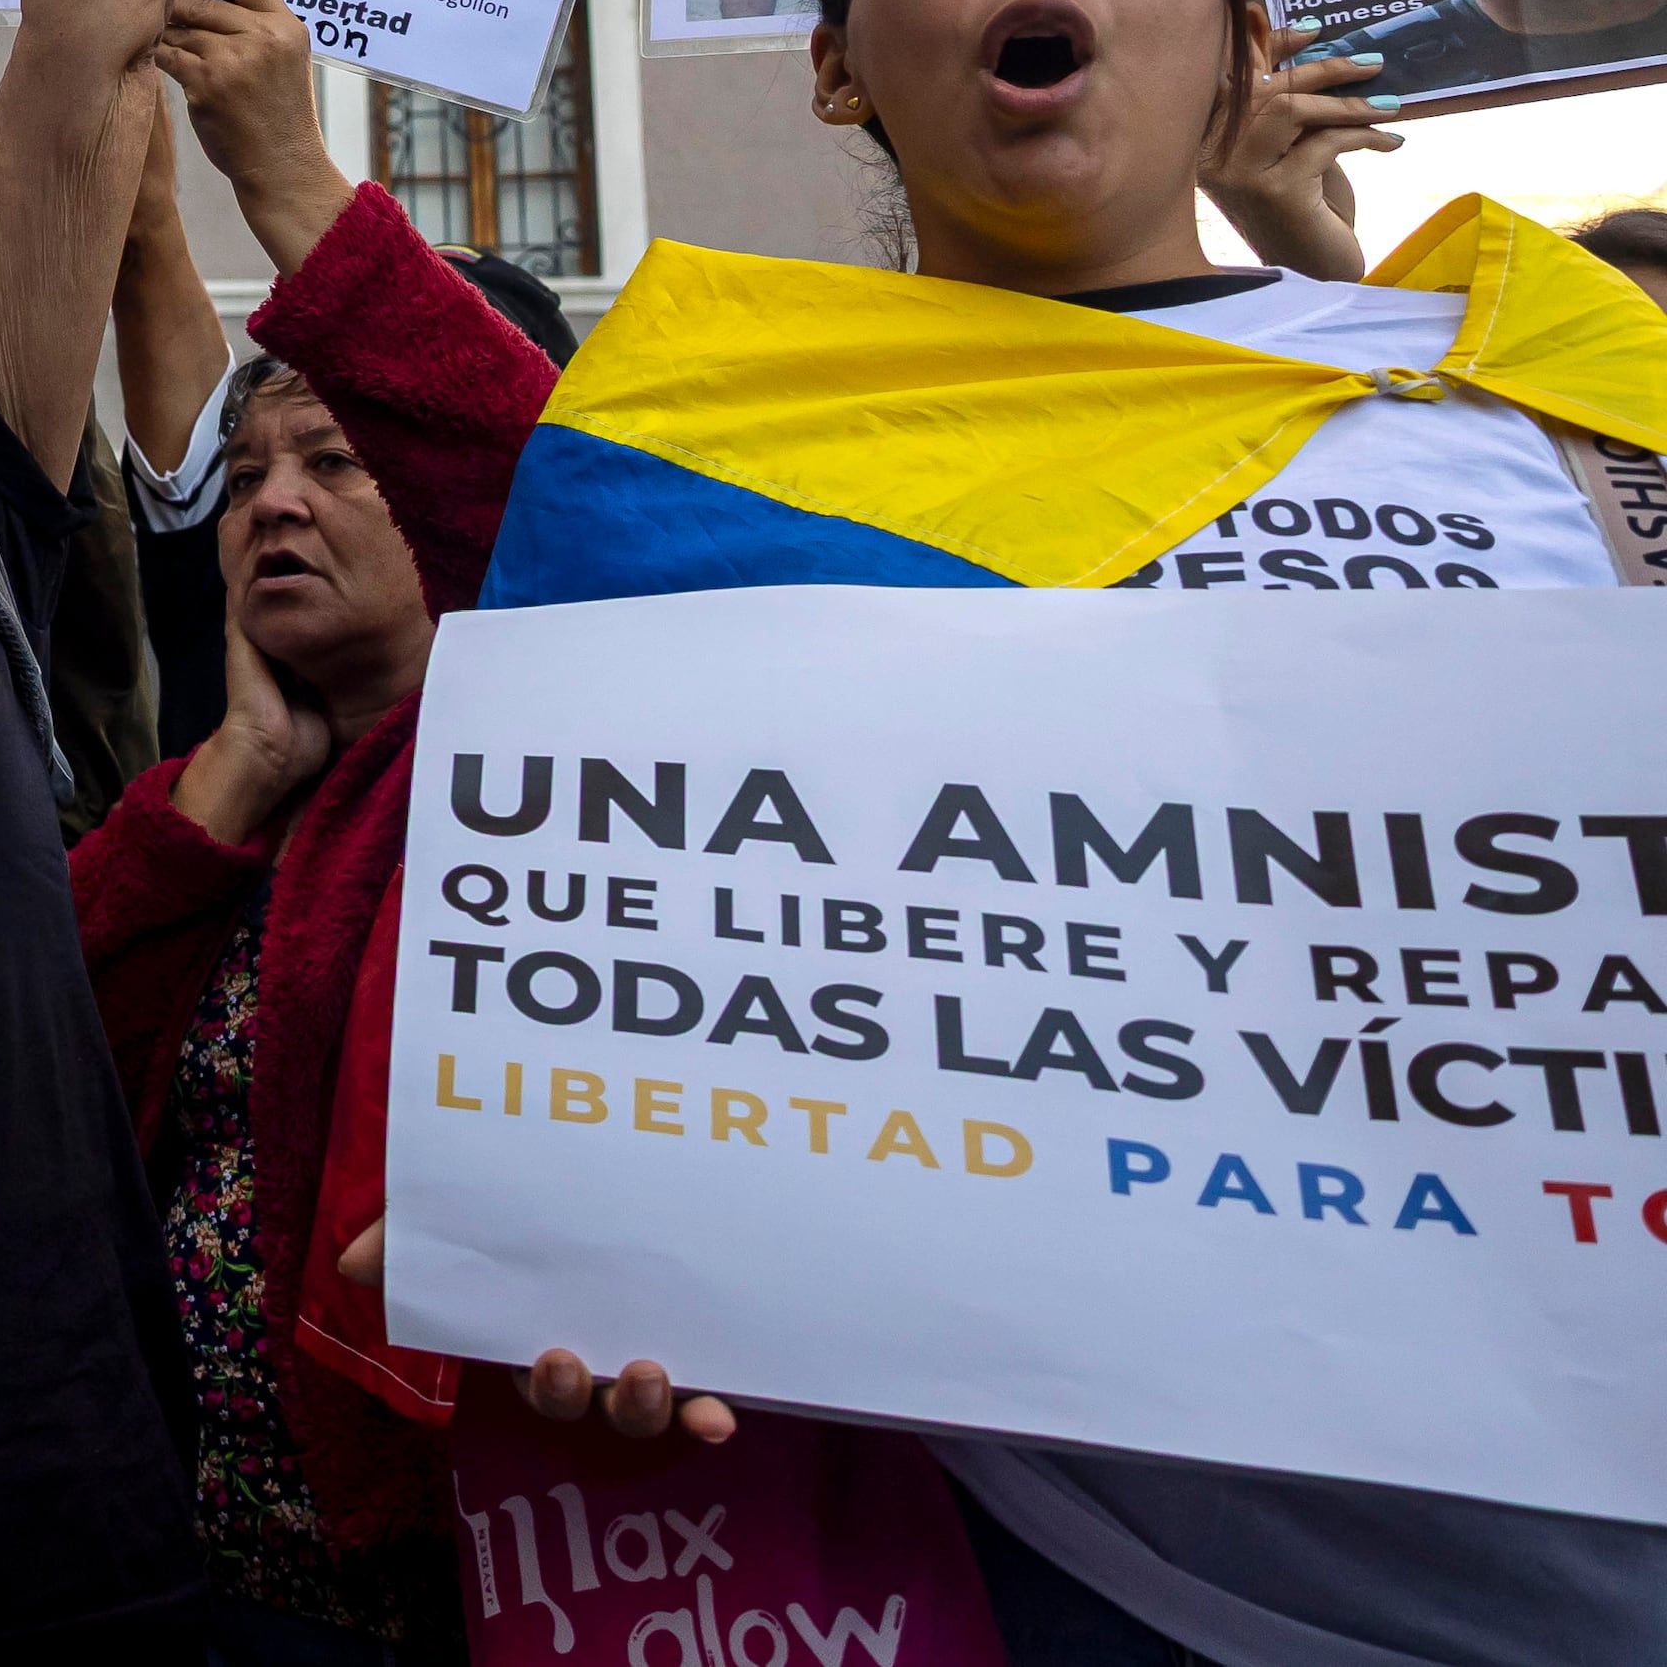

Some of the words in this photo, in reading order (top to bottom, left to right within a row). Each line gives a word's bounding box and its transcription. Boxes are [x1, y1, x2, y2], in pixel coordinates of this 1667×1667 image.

[1214, 497, 1497, 552] TODOS
[449, 751, 836, 866] UNA
[896, 781, 1667, 918] AMNIST
[440, 862, 660, 931] QUE
[714, 885, 1127, 984] LIBERE
[1176, 933, 1249, 995] Y
[1310, 944, 1667, 1015] REPA
[427, 939, 892, 1064] TODAS
[932, 993, 1206, 1103] LAS
[1236, 1014, 1667, 1140] VÍCTI
[434, 1052, 1036, 1179] LIBERTAD
[1104, 1137, 1479, 1238] PARA
